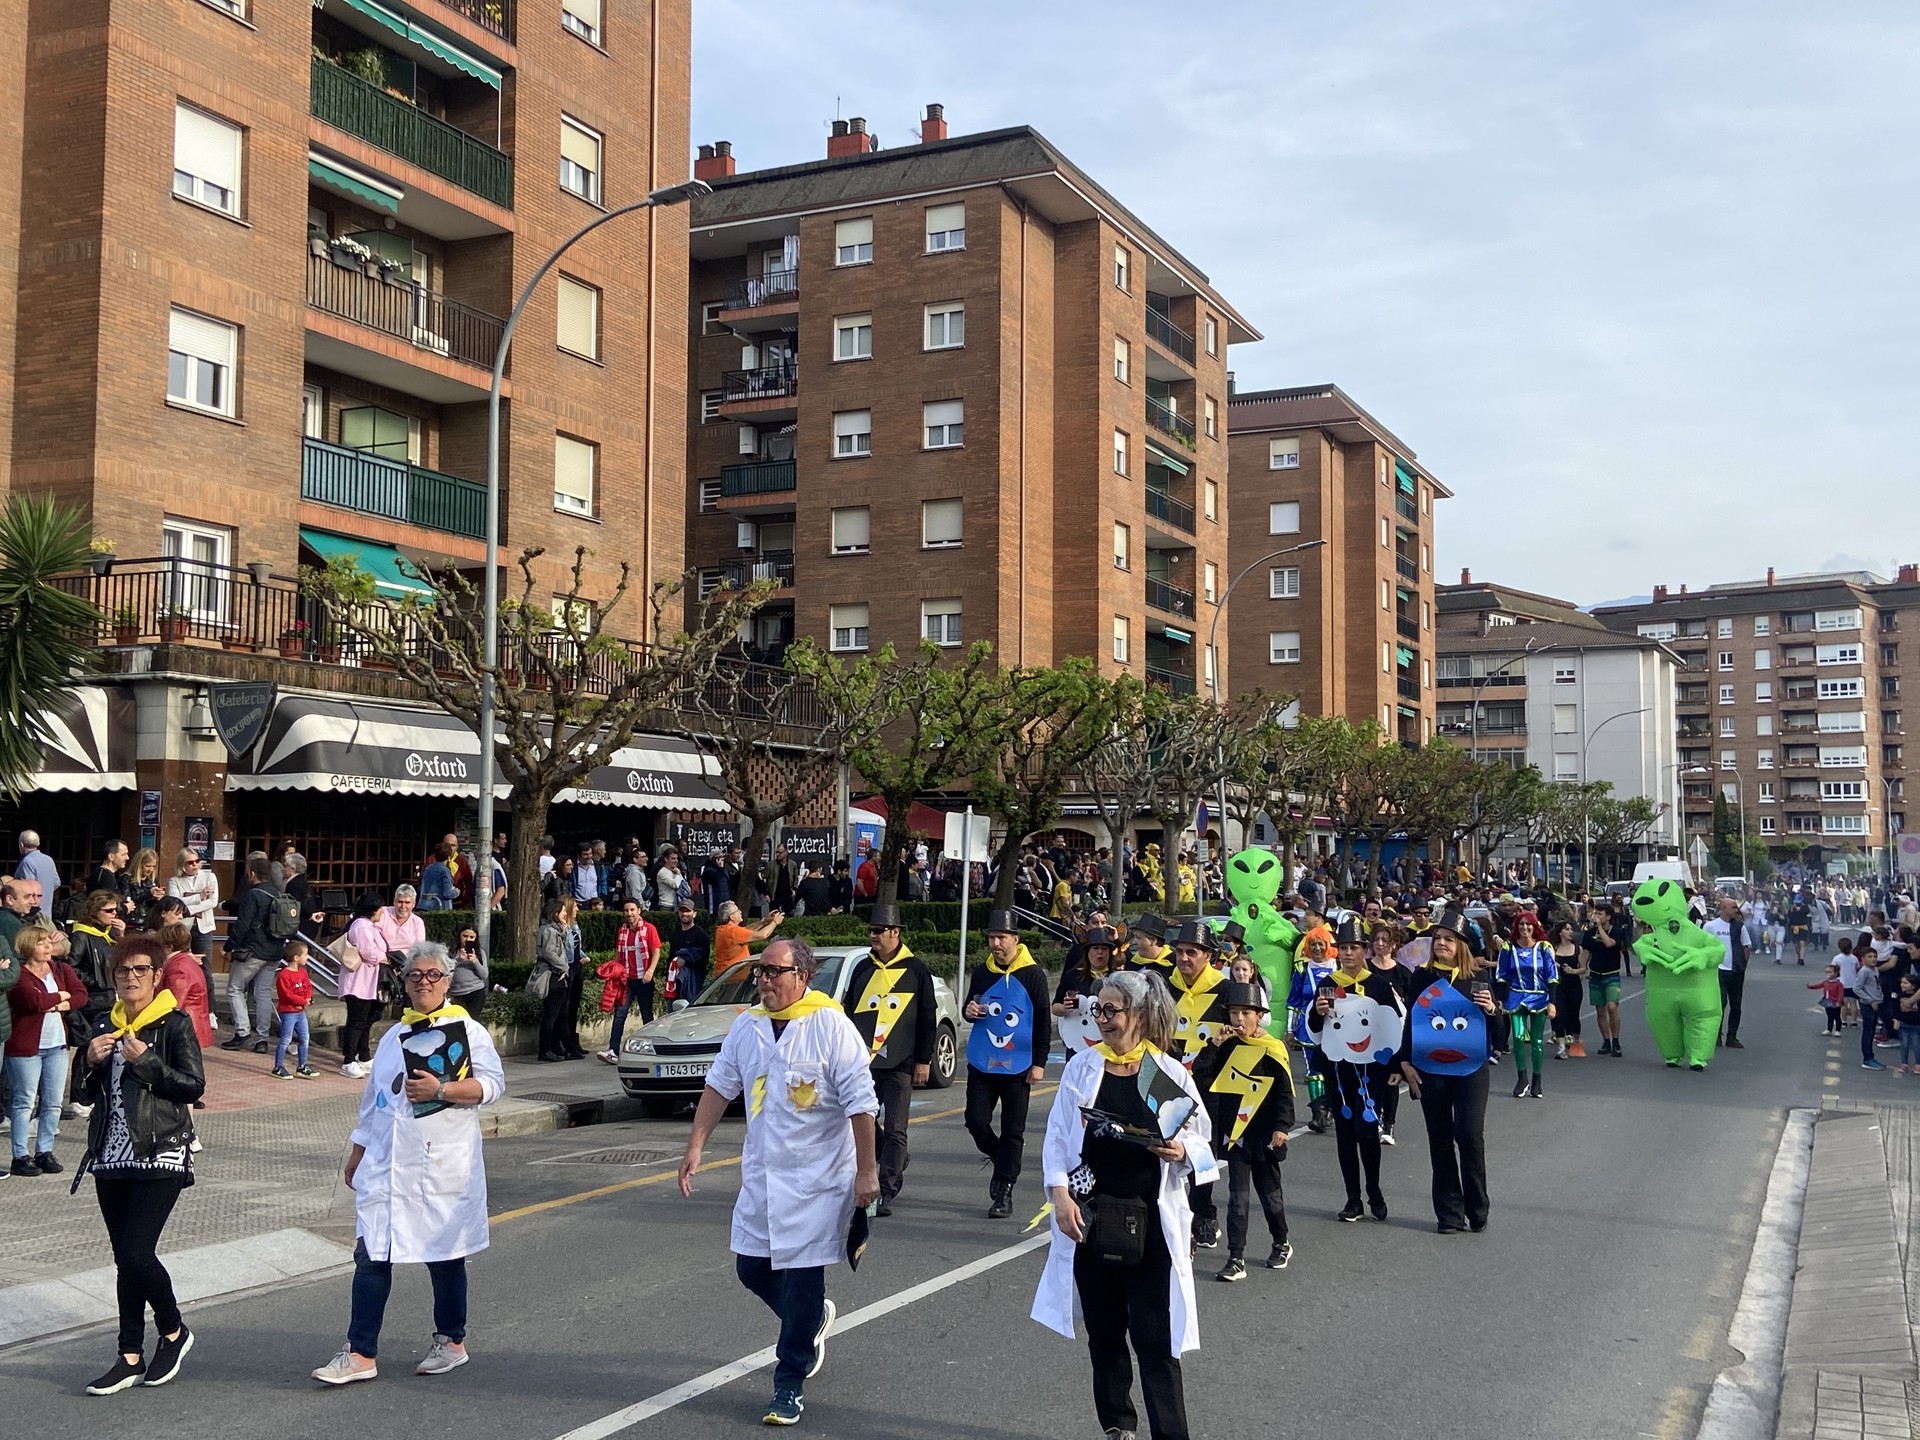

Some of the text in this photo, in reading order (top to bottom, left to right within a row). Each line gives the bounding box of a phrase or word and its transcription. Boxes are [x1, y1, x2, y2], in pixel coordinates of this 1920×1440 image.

[405, 752, 467, 778] Oxford
[331, 775, 392, 790] CAFETERIA
[627, 770, 674, 793] Oxford
[576, 790, 611, 801] CAFETERIA
[687, 828, 734, 843] Preso eta
[786, 832, 830, 854] etxera!
[665, 1065, 688, 1076] 1643
